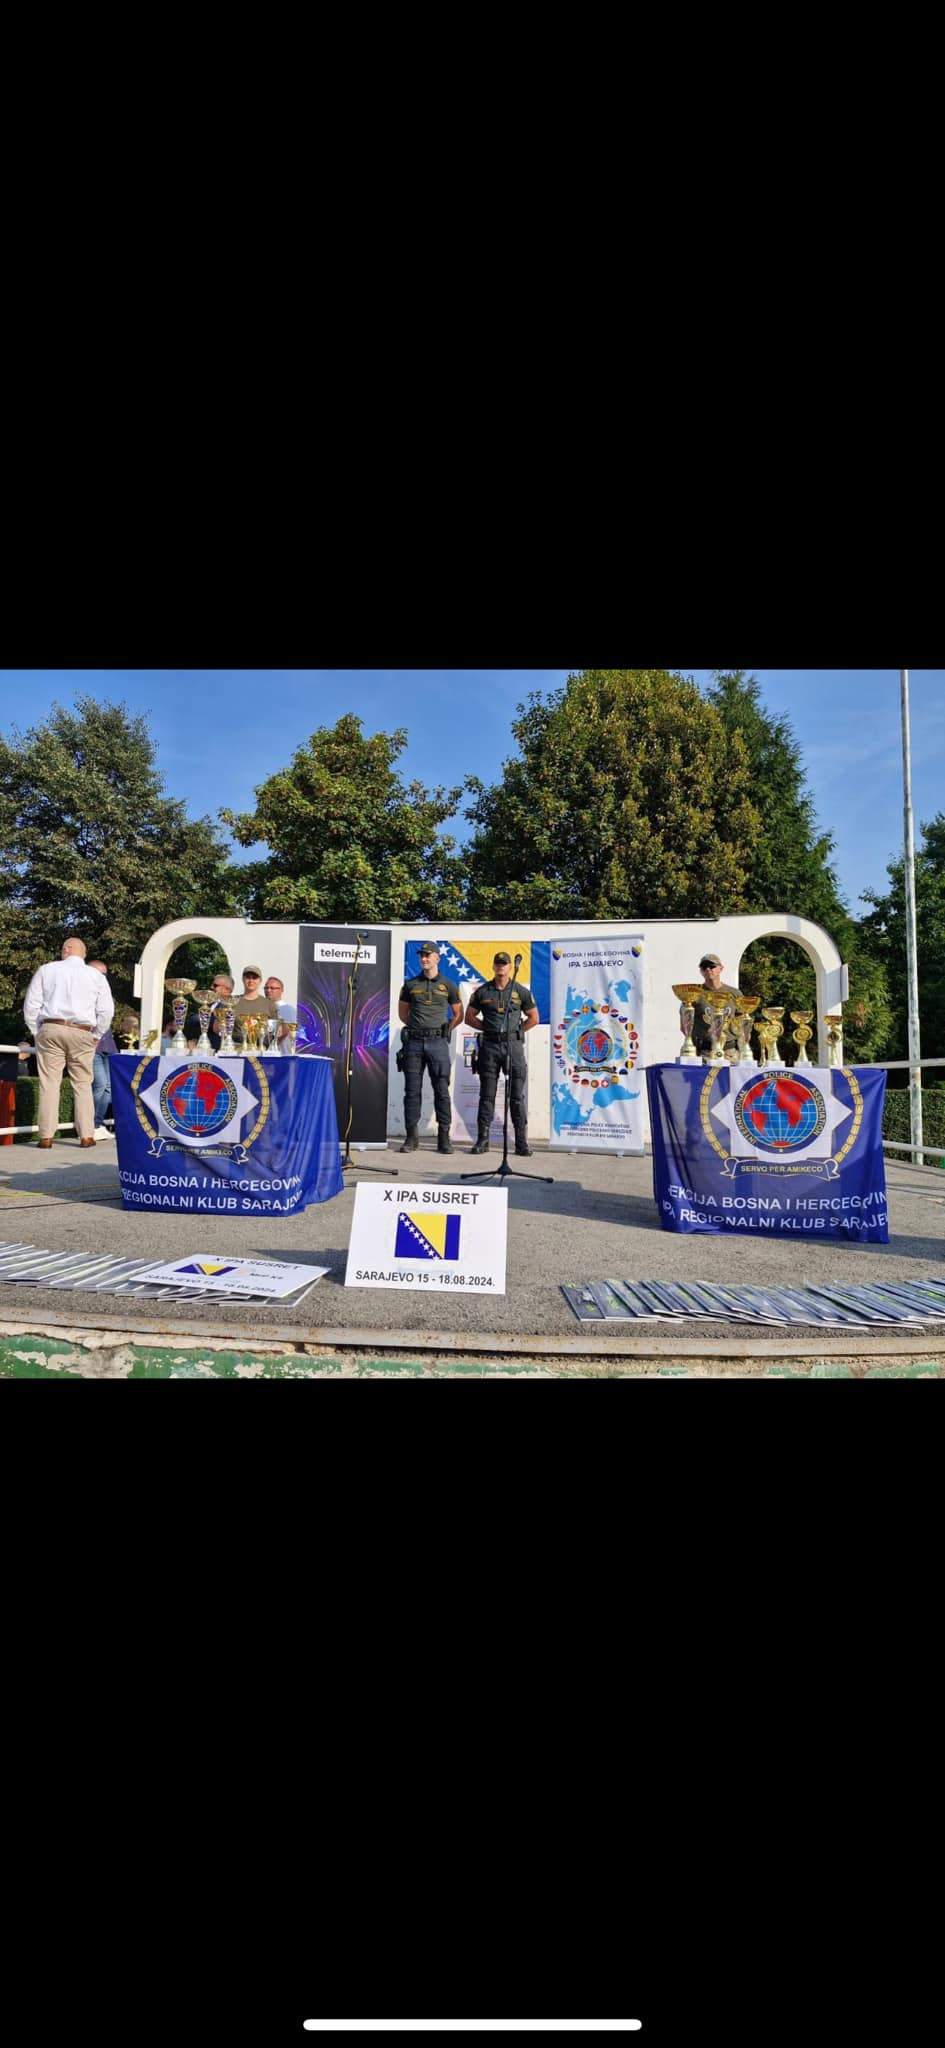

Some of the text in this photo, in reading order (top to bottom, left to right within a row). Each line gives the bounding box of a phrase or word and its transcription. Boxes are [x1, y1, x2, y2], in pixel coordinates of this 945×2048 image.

[583, 959, 624, 968] SARAJEVO
[763, 1071, 793, 1080] POLICE
[735, 1089, 756, 1145] INTERNATIONAL
[810, 1087, 825, 1136] ASSOCIATION
[149, 1174, 199, 1188] BOSNA
[202, 1177, 207, 1188] I
[197, 1196, 237, 1209] KLUB
[383, 1190, 479, 1205] X IPA SUSRET
[668, 1184, 718, 1208] EKCIJA
[722, 1196, 781, 1210] BOSNA
[786, 1198, 791, 1210] I
[680, 1208, 775, 1228] REGIONALNI
[780, 1217, 825, 1229] KLUB
[355, 1270, 414, 1283] SARAJEVO
[418, 1274, 429, 1283] 15
[439, 1273, 496, 1287] 18.08.2024.
